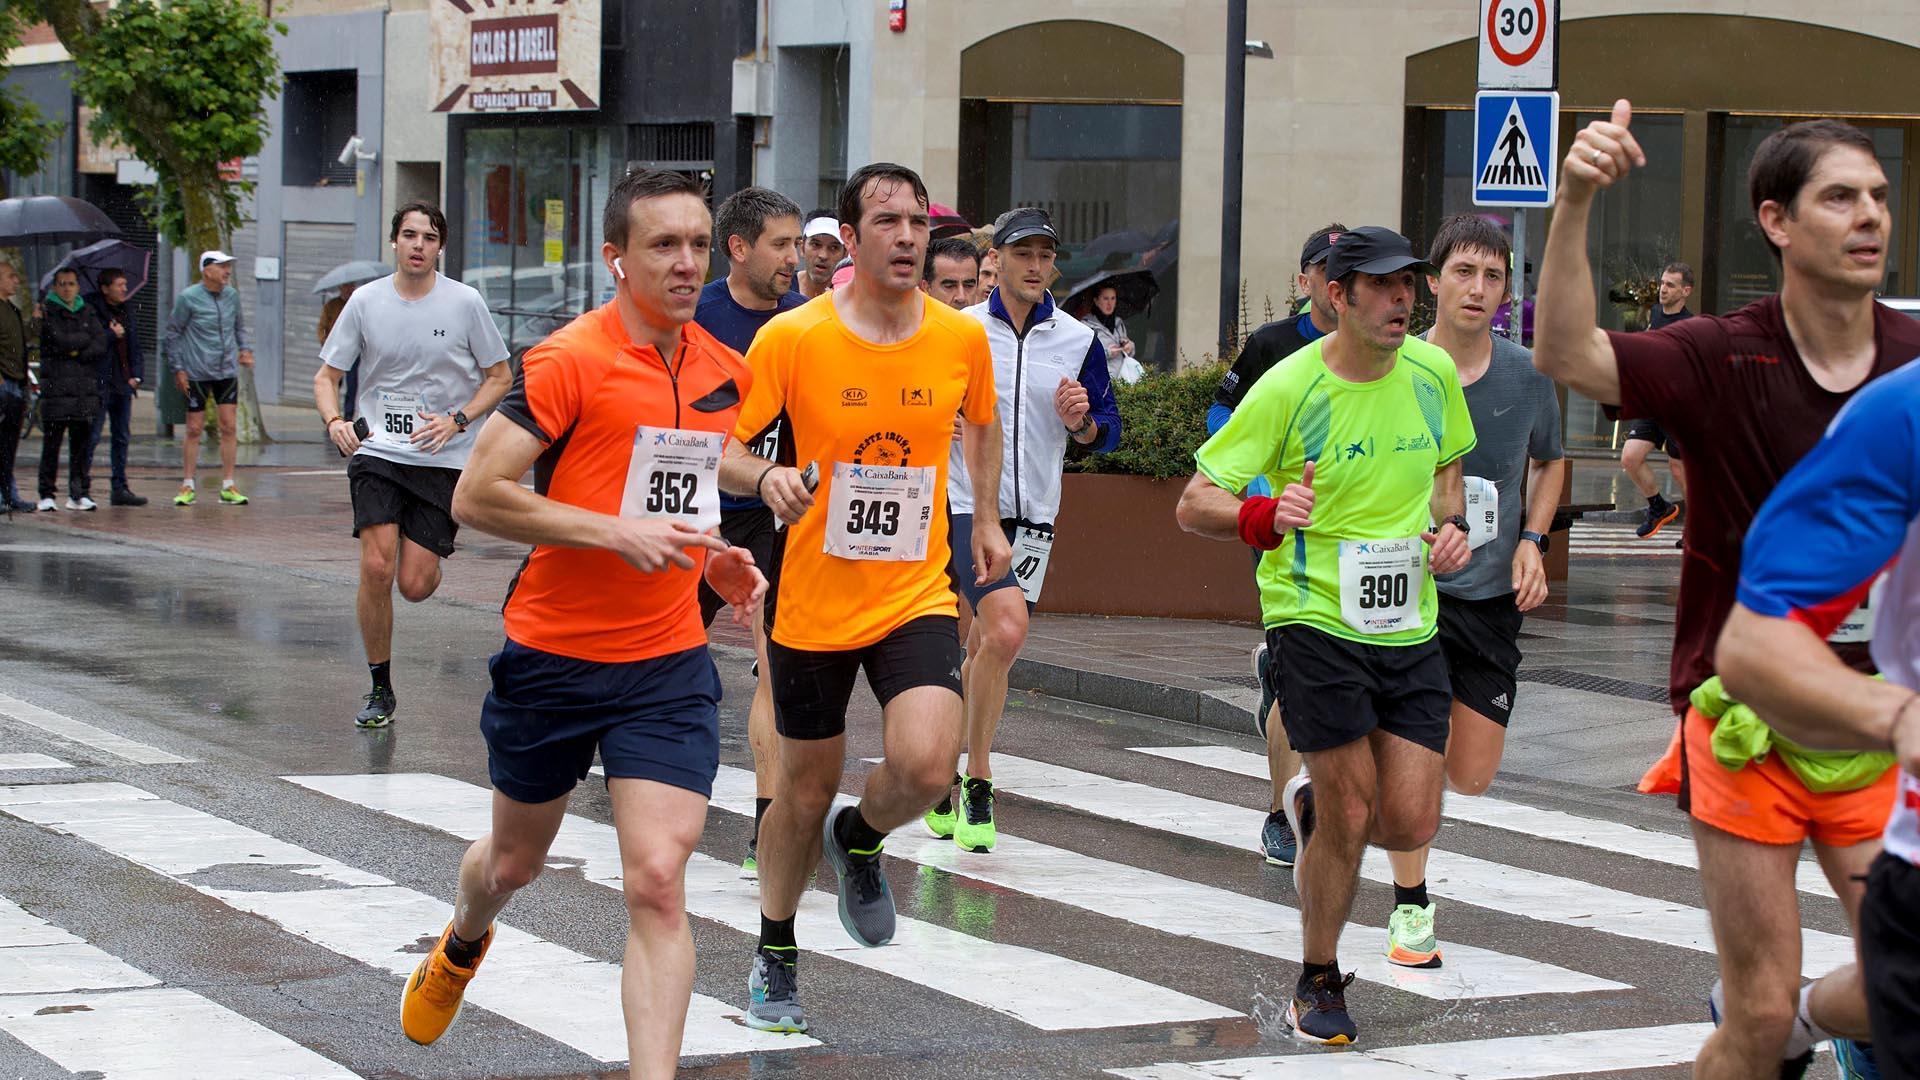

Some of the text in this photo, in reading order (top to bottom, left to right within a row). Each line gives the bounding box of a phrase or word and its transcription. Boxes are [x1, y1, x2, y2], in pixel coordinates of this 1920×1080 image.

[1500, 7, 1533, 36] 30
[472, 30, 507, 64] CICLOS
[518, 26, 556, 62] ROSELL
[529, 92, 552, 106] VENTA
[385, 413, 413, 434] 356
[669, 432, 709, 448] CaixaBank
[865, 469, 909, 480] CaixaBank
[647, 471, 699, 514] 352
[847, 499, 900, 536] 343
[921, 506, 930, 520] 343
[1485, 510, 1494, 524] 430
[1371, 542, 1410, 554] CaixaBank
[1014, 555, 1041, 580] 47
[1359, 573, 1408, 609] 390
